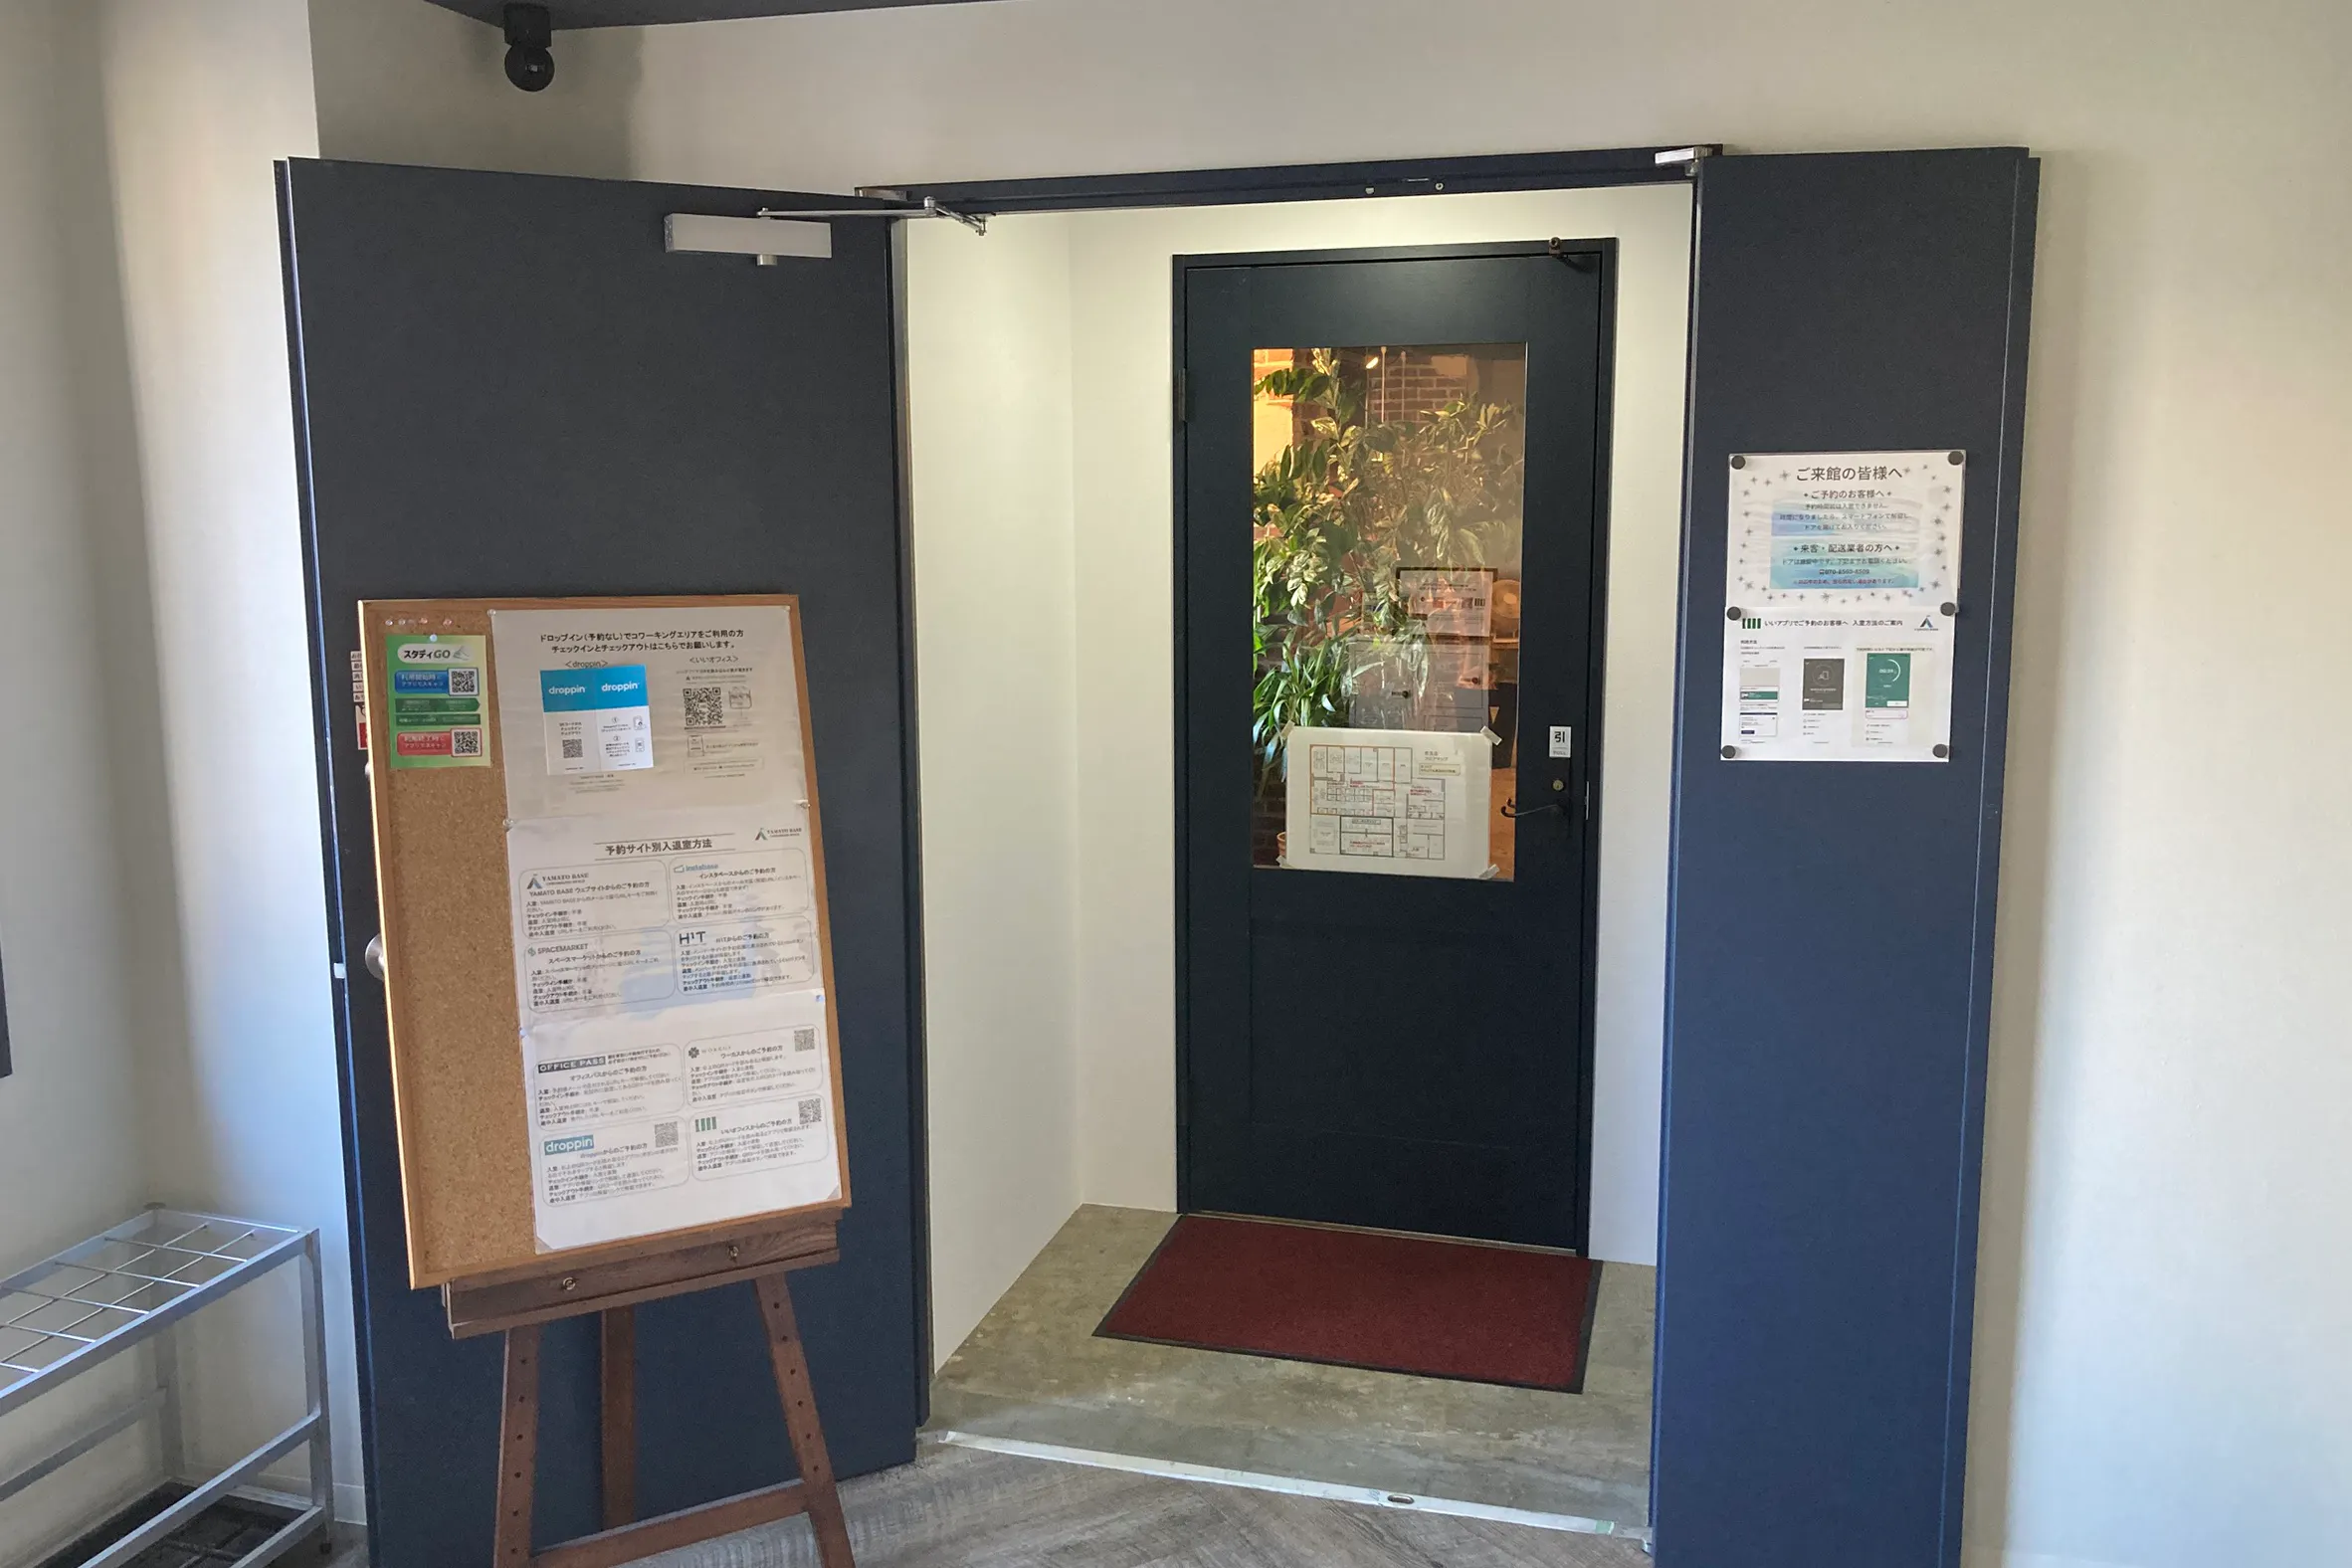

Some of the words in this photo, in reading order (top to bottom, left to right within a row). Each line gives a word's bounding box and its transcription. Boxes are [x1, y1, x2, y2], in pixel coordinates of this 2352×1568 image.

[1797, 467, 1902, 481] ご来館の皆様へ
[1811, 490, 1884, 498] ご予約のお客様へ
[1801, 544, 1892, 553] 来客・配送業者の方へ
[551, 641, 736, 654] チェックインとチェックアウトはこちらでお願いします。
[404, 650, 451, 659] スタディGO
[549, 686, 585, 695] droppin
[602, 682, 639, 692] droppin
[1554, 731, 1565, 742] 引
[605, 839, 712, 856] 予約サイト別入退室方法
[575, 882, 650, 893] ウェブサイトからのご予約の方
[537, 943, 588, 954] SPACEMARKET
[549, 950, 641, 964] スペースマーケットからのご予約の方
[539, 1061, 576, 1072] OFFICE
[580, 1057, 605, 1067] PASS
[546, 1137, 593, 1152] droppin
